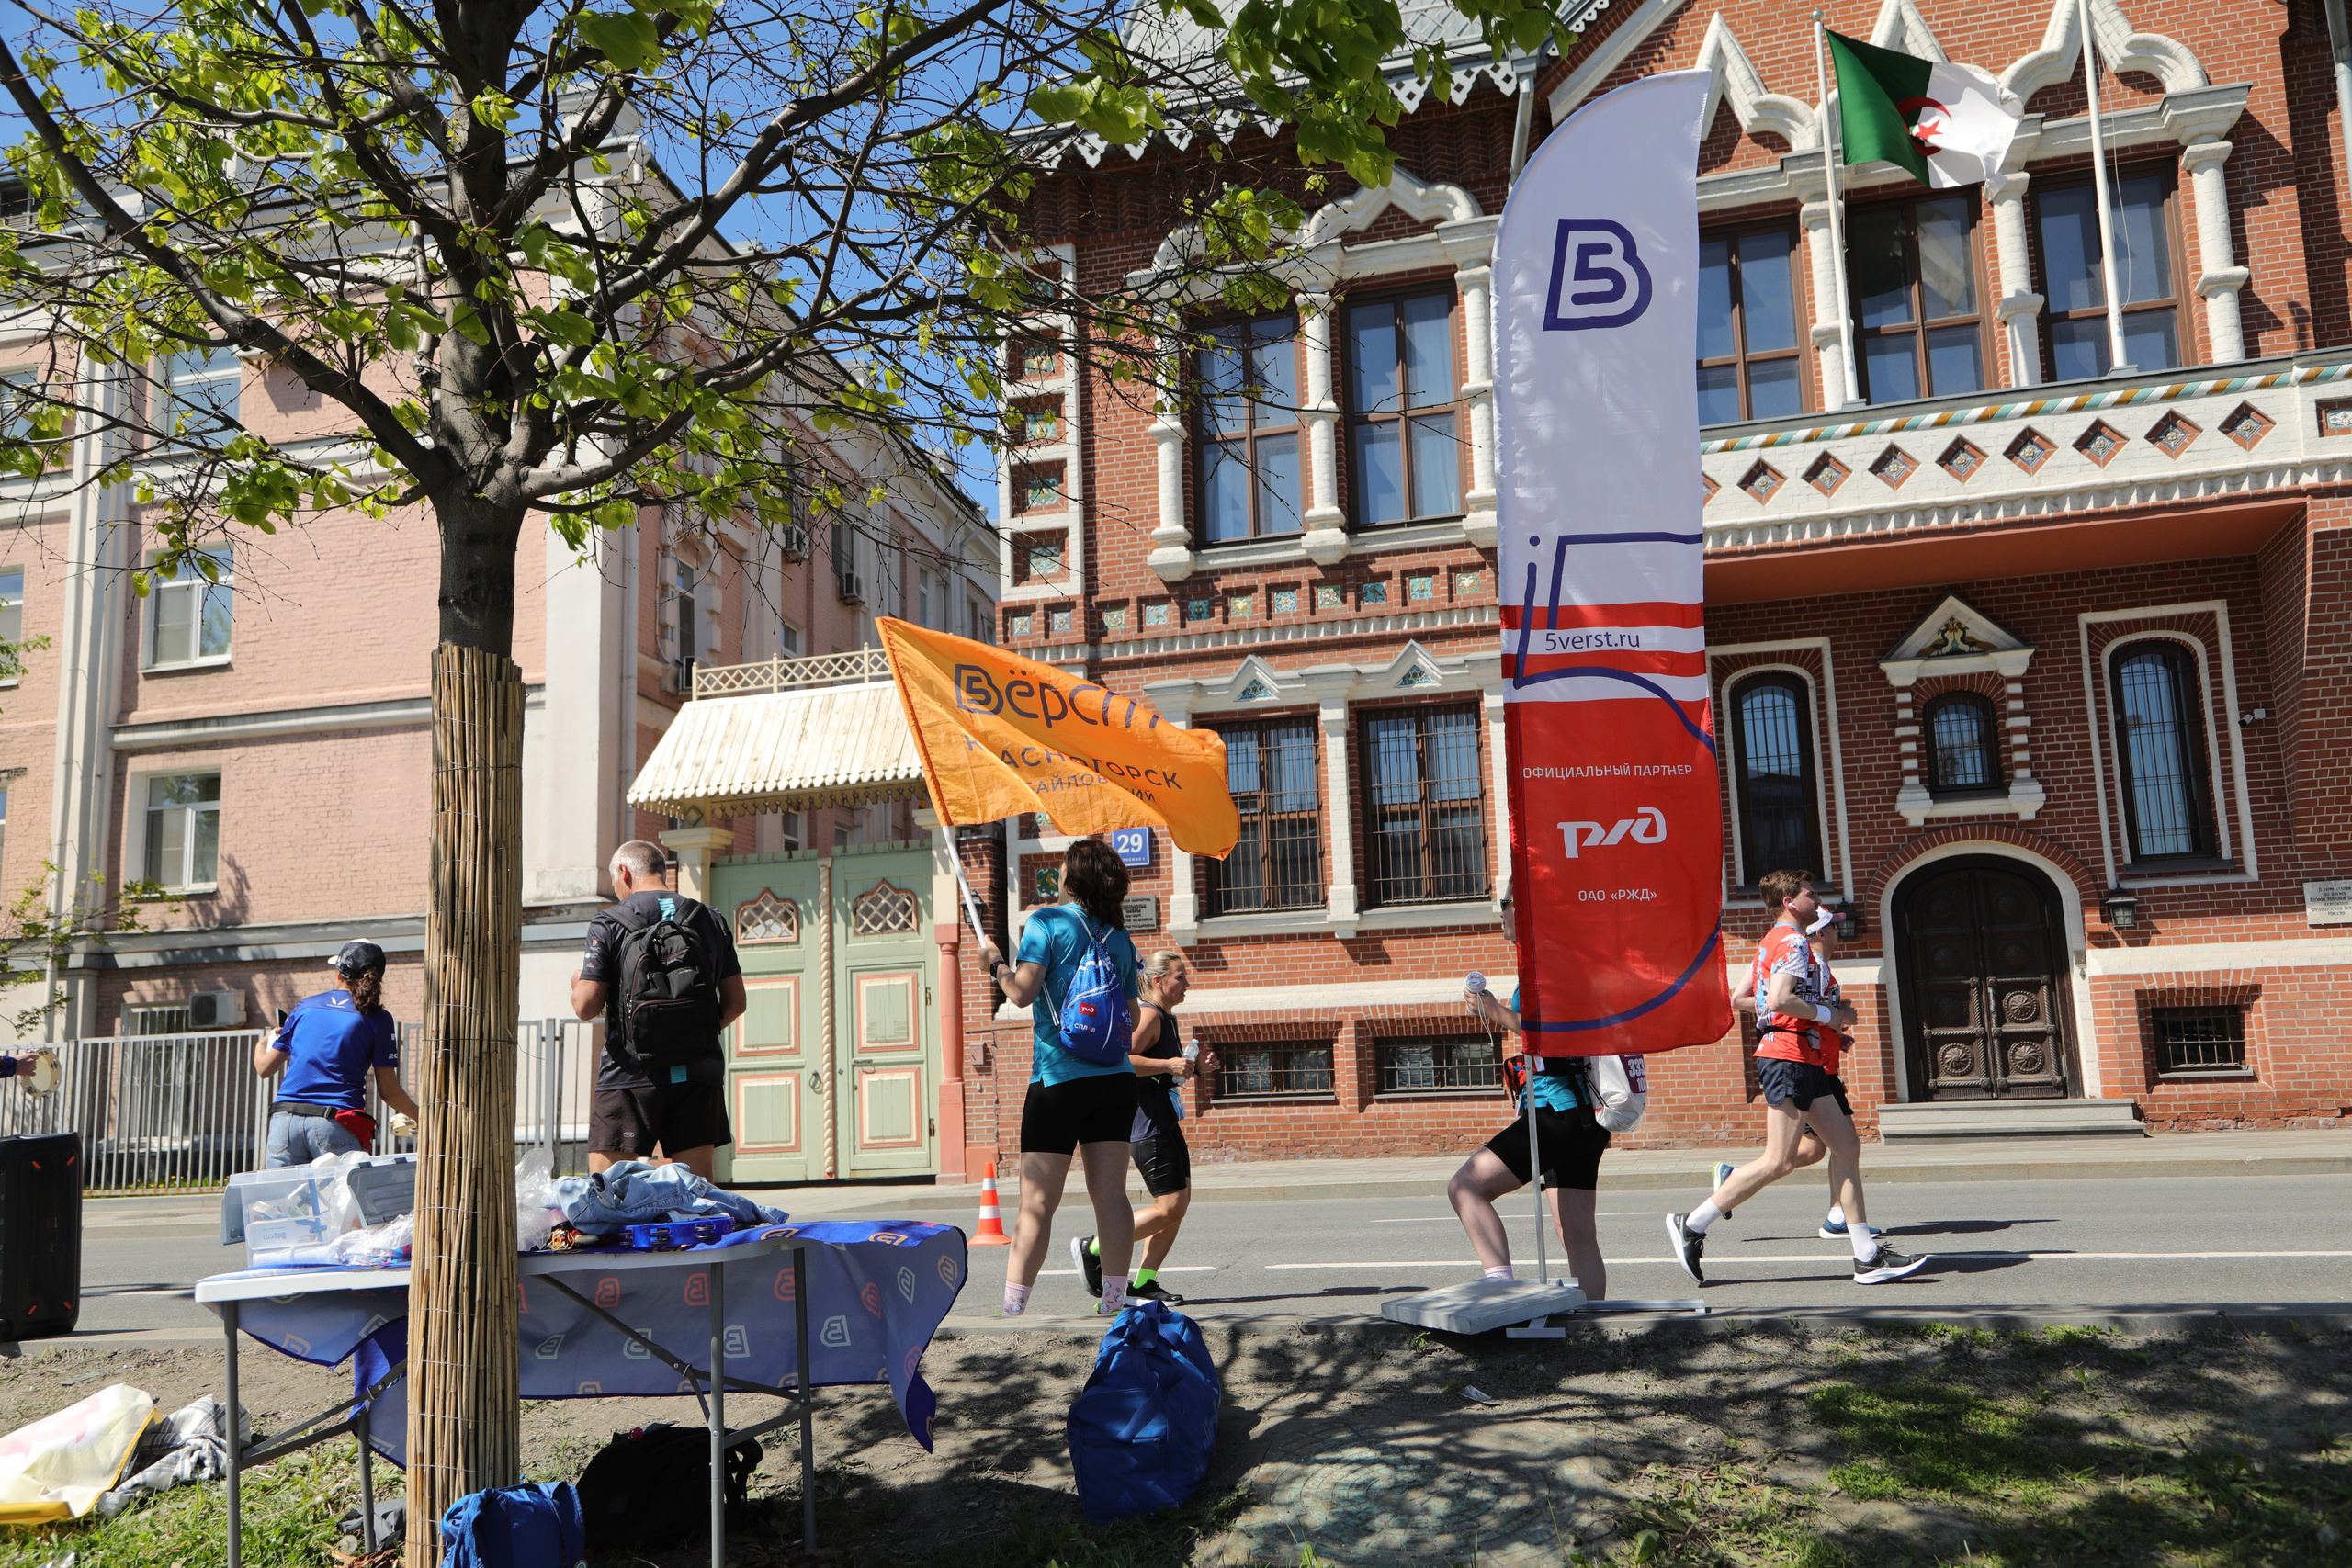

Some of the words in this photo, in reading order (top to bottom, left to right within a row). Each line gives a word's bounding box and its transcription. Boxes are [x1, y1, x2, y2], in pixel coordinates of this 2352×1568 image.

[1544, 631, 1641, 651] 5verst.ru
[1522, 763, 1631, 781] ОФИЦИАЛЬНЫЙ
[1634, 764, 1692, 776] ПАРТНЕР
[1116, 833, 1143, 854] 29
[1578, 890, 1606, 901] ОАО
[1611, 888, 1657, 902] «РЖД»
